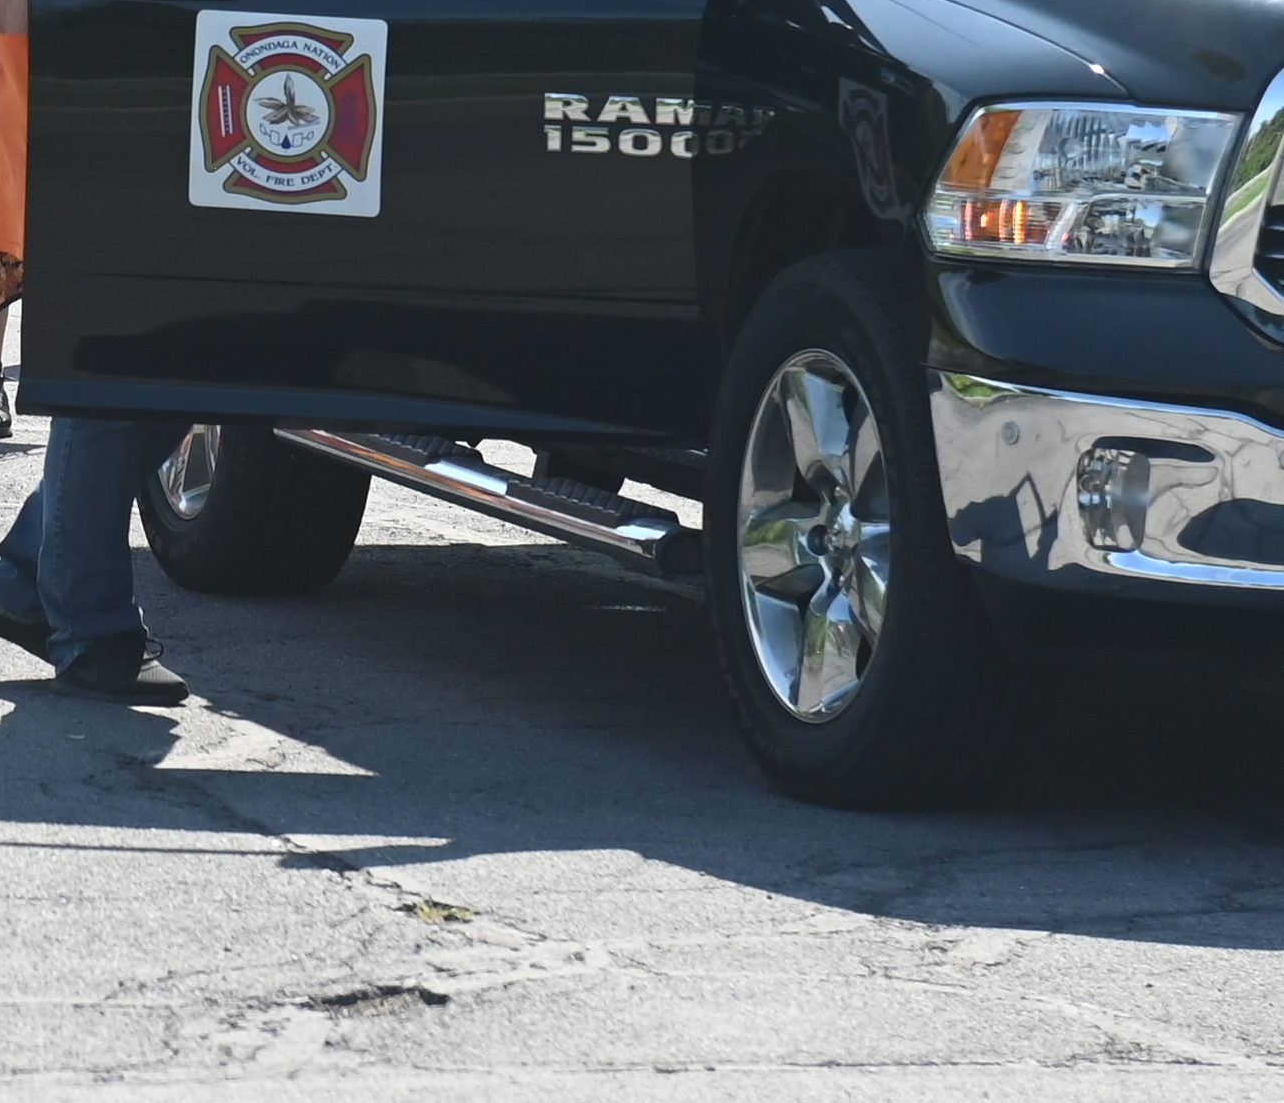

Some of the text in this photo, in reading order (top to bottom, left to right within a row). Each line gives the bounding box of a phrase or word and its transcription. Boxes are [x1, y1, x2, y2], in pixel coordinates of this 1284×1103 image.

[239, 40, 342, 70] ONONDAGA NATION
[544, 92, 694, 125] RAM
[236, 156, 338, 187] VOL. FIRE DEPT.
